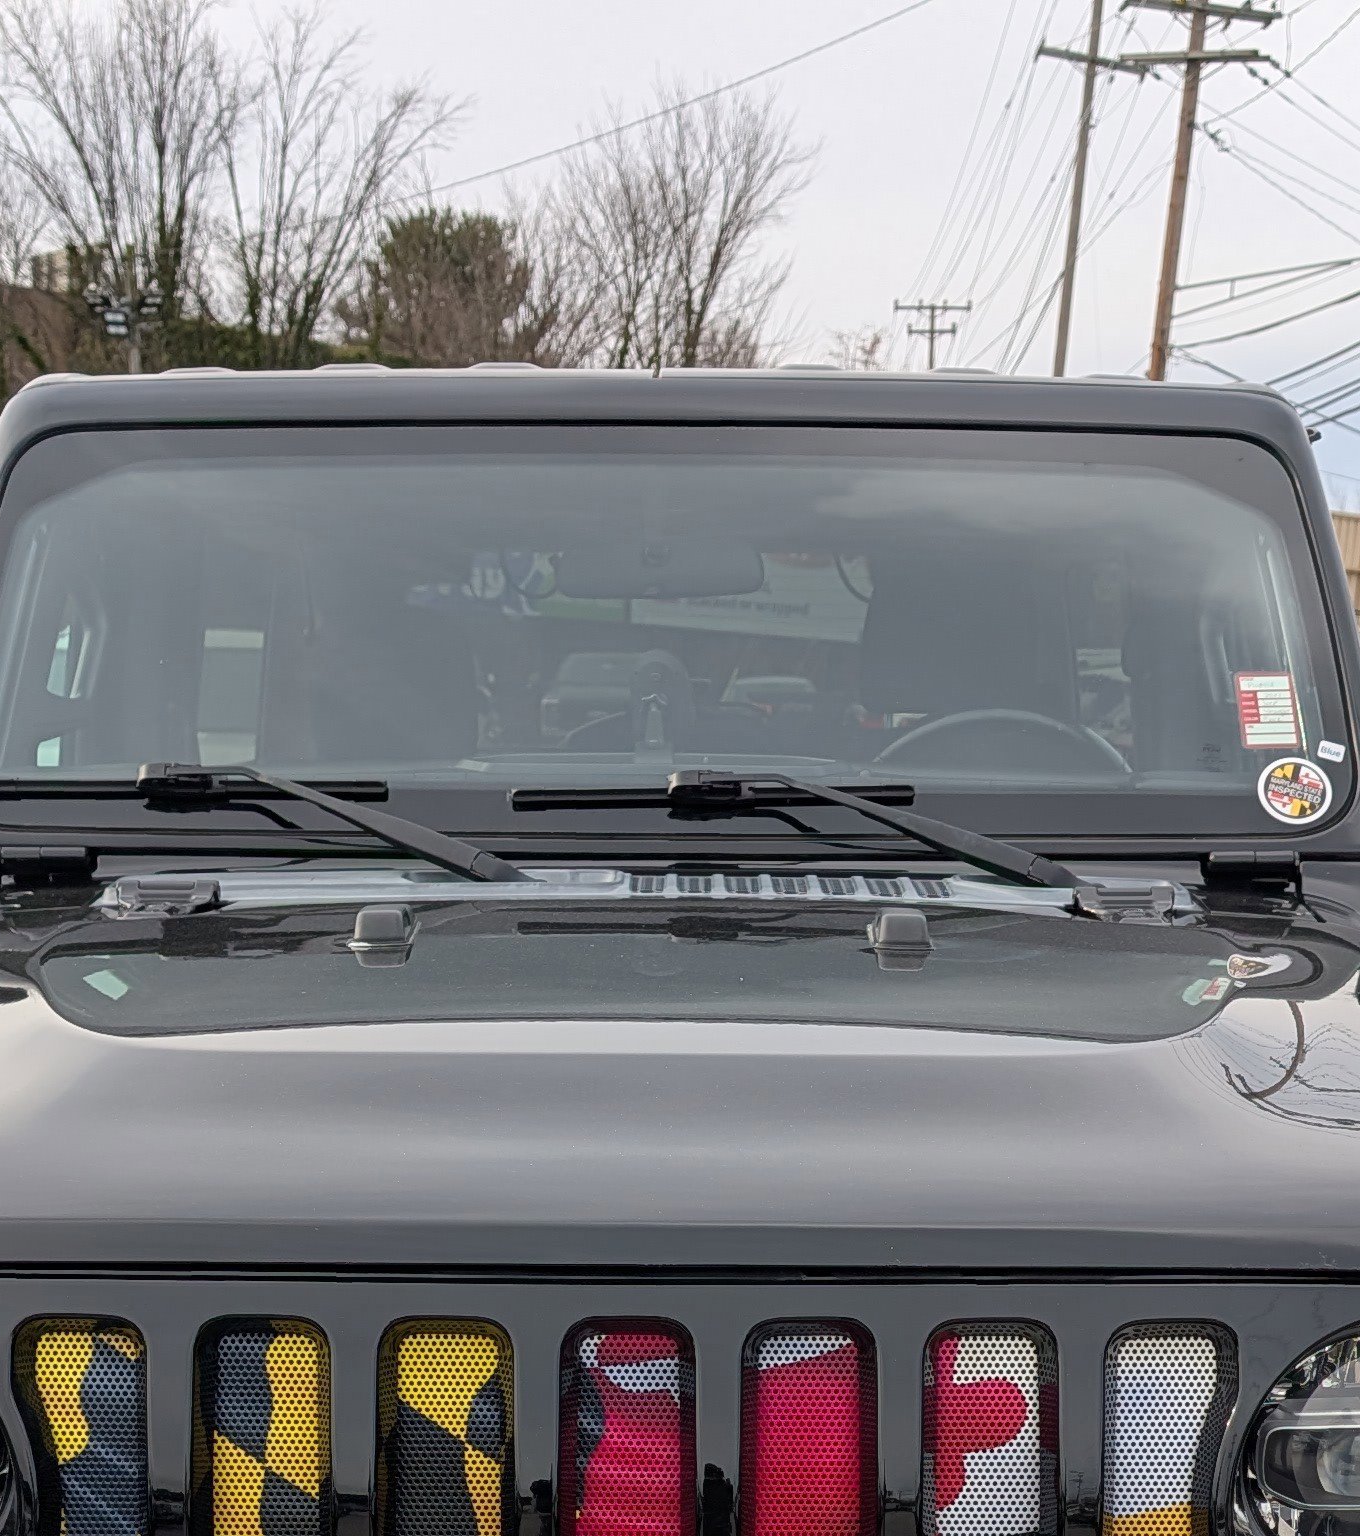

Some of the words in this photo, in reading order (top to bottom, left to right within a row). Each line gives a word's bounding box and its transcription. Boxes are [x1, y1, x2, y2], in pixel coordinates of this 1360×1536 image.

[1268, 782, 1323, 804] INSPECTED
[1270, 776, 1304, 791] MARYLAND
[1303, 785, 1324, 797] STATE
